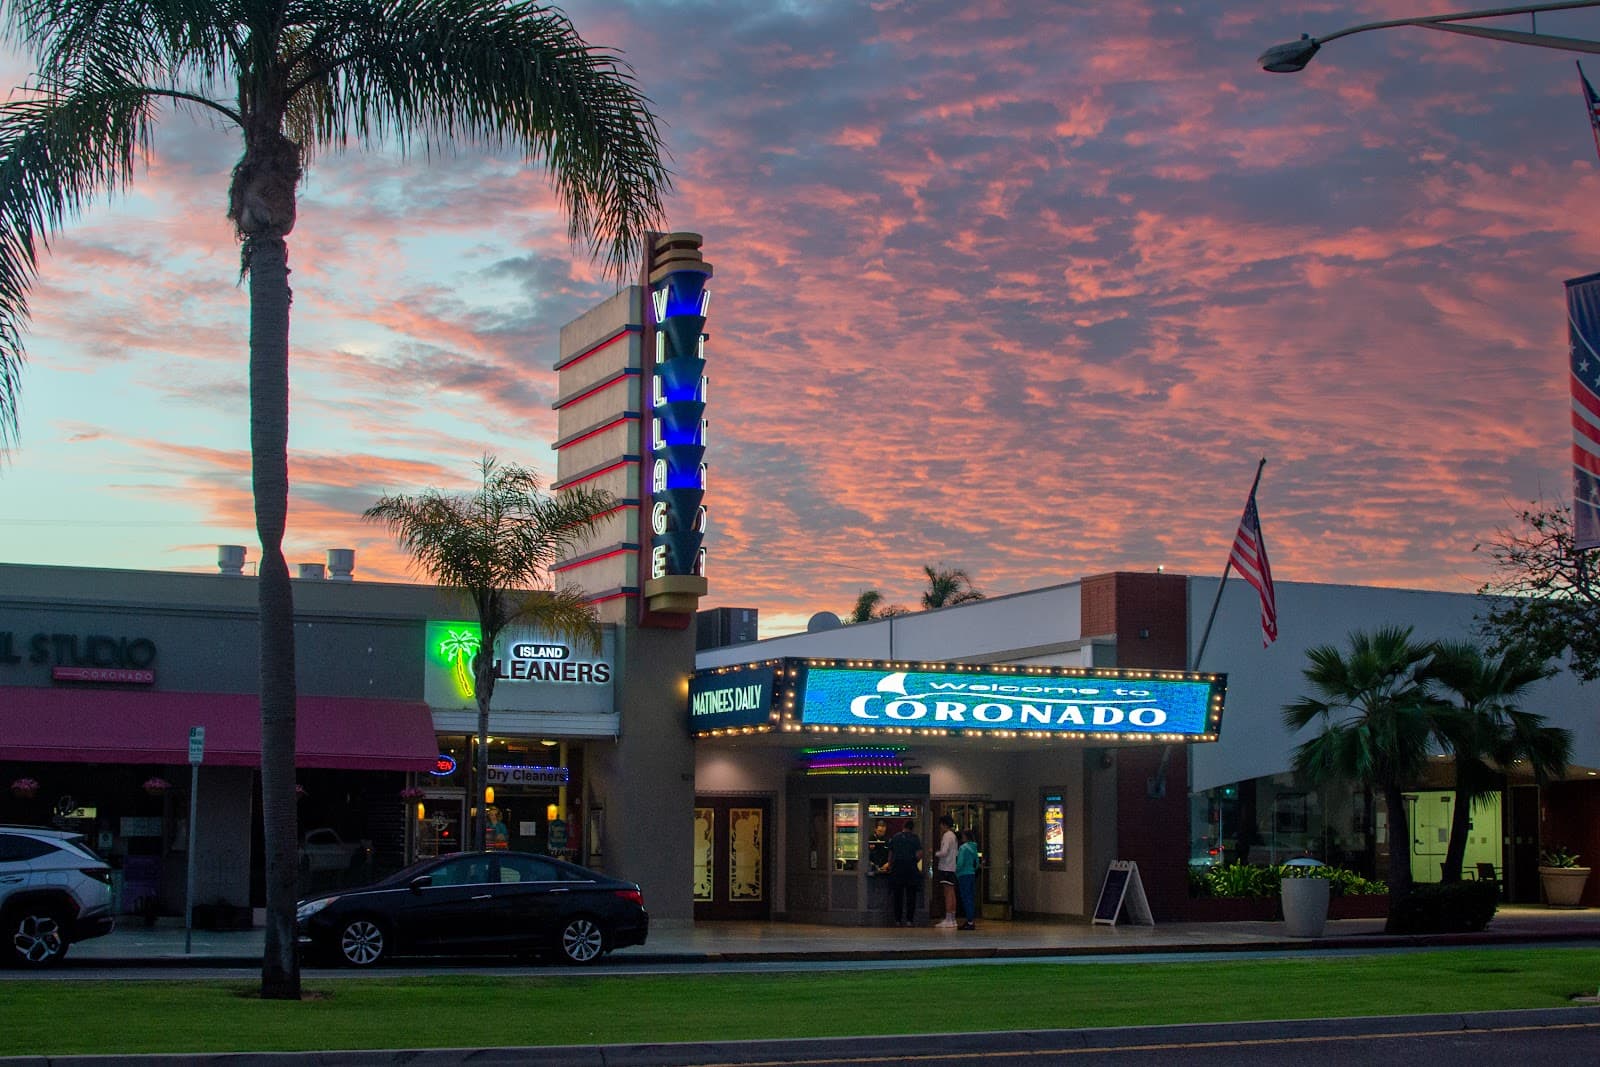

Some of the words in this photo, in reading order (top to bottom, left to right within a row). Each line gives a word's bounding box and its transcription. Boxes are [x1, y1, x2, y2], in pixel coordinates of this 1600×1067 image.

[652, 284, 669, 580] VILLAGE
[30, 633, 157, 668] STUDIO
[520, 646, 563, 659] ISLAND
[80, 670, 153, 681] CORONADO
[472, 659, 610, 682] LEANERS
[692, 688, 734, 716] MATINEES
[735, 684, 762, 710] DAILY
[929, 681, 1100, 695] Welcome
[1113, 687, 1150, 697] to
[849, 694, 1168, 727] CORONADO
[487, 768, 509, 783] Dry
[512, 769, 566, 782] Cleaners
